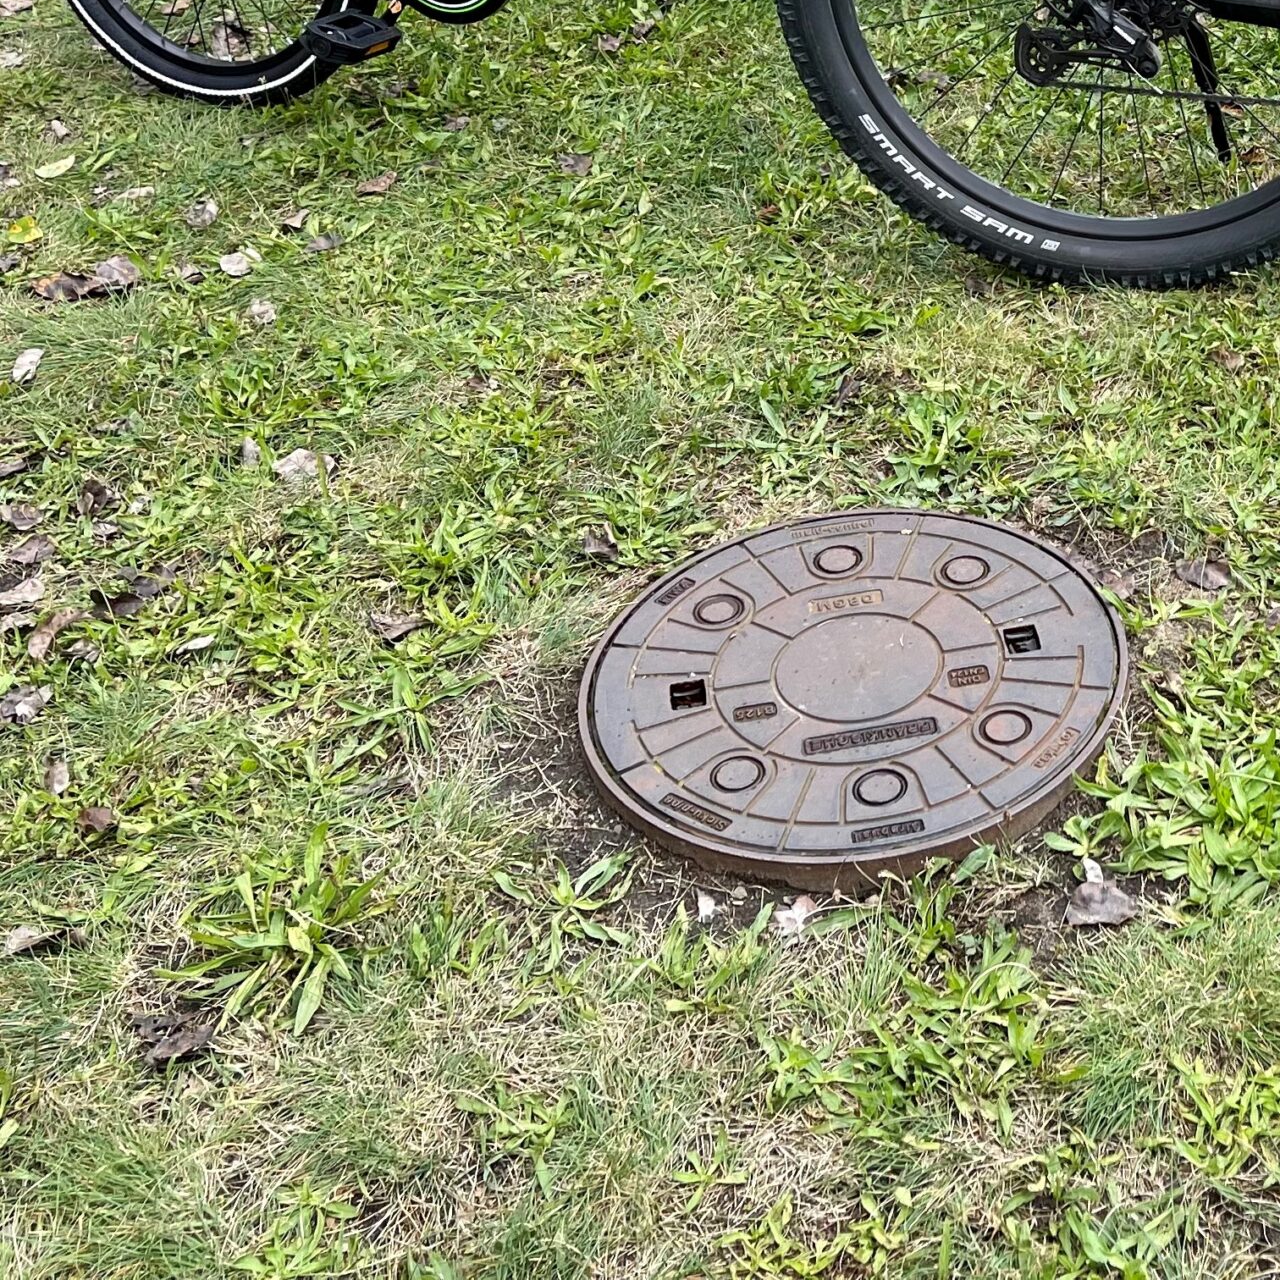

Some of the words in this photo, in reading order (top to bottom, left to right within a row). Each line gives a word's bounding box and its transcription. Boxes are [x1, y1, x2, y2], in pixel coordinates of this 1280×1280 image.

[857, 113, 955, 202] SMART
[960, 205, 1034, 245] SAM
[735, 703, 776, 721] B125
